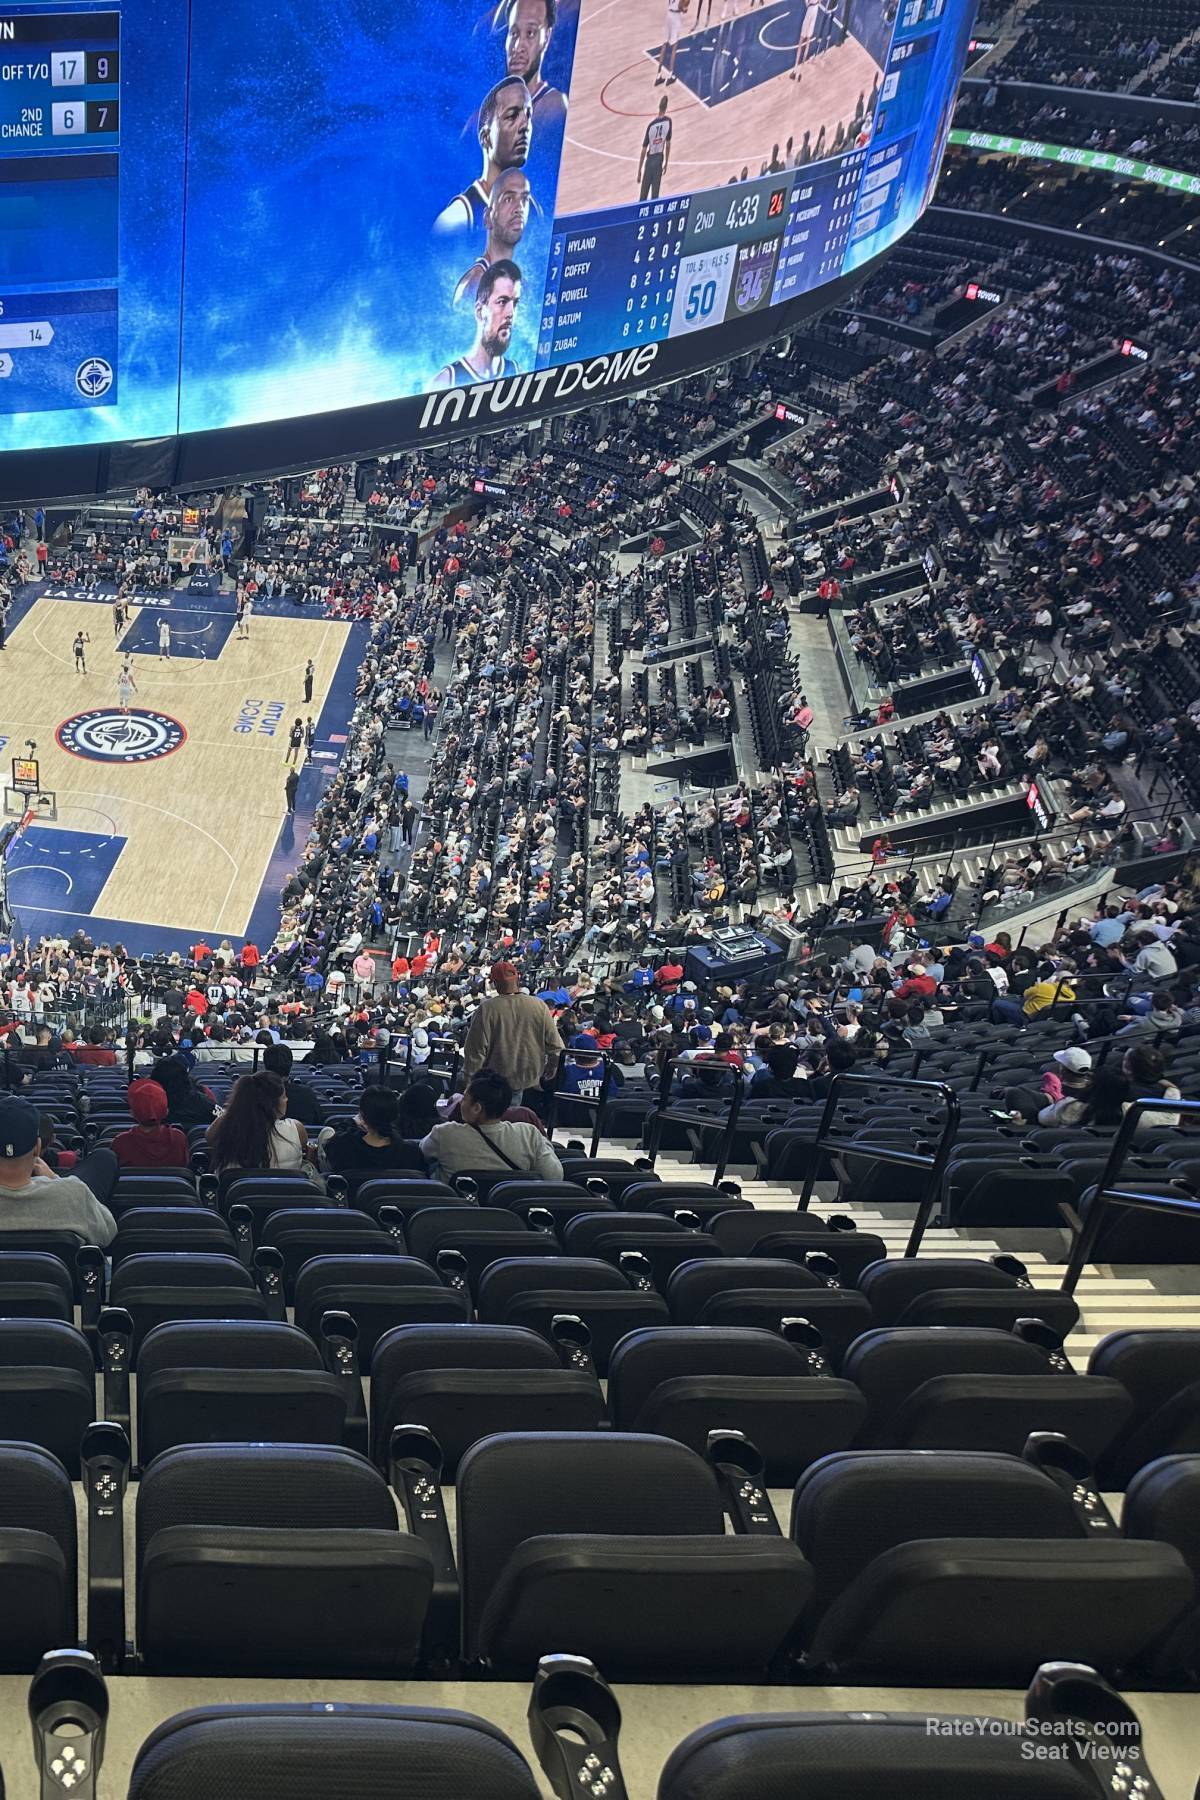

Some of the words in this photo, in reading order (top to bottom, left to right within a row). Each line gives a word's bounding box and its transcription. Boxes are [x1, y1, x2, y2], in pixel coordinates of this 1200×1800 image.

[2, 65, 23, 80] OFF
[60, 60, 76, 80] 17
[98, 58, 108, 78] 9
[22, 109, 42, 121] 2ND
[64, 110, 74, 129] 6
[98, 108, 107, 127] 7
[2, 124, 42, 138] CHANCE
[694, 212, 714, 233] 2ND
[726, 194, 759, 229] 4:33
[769, 193, 783, 216] 24
[568, 237, 596, 252] HYLAND
[565, 263, 591, 277] COFFEY
[738, 269, 764, 305] 34
[561, 288, 588, 303] POWELL
[686, 281, 717, 320] 50
[558, 312, 581, 327] BATUM
[30, 329, 42, 341] 14
[554, 337, 577, 352] ZUBAC
[485, 485, 506, 495] TOYOTA
[44, 590, 67, 598] LA
[148, 713, 174, 727] LOS
[62, 712, 101, 752] CLIPPERS
[125, 731, 179, 761] ANGELES
[210, 987, 219, 997] 11
